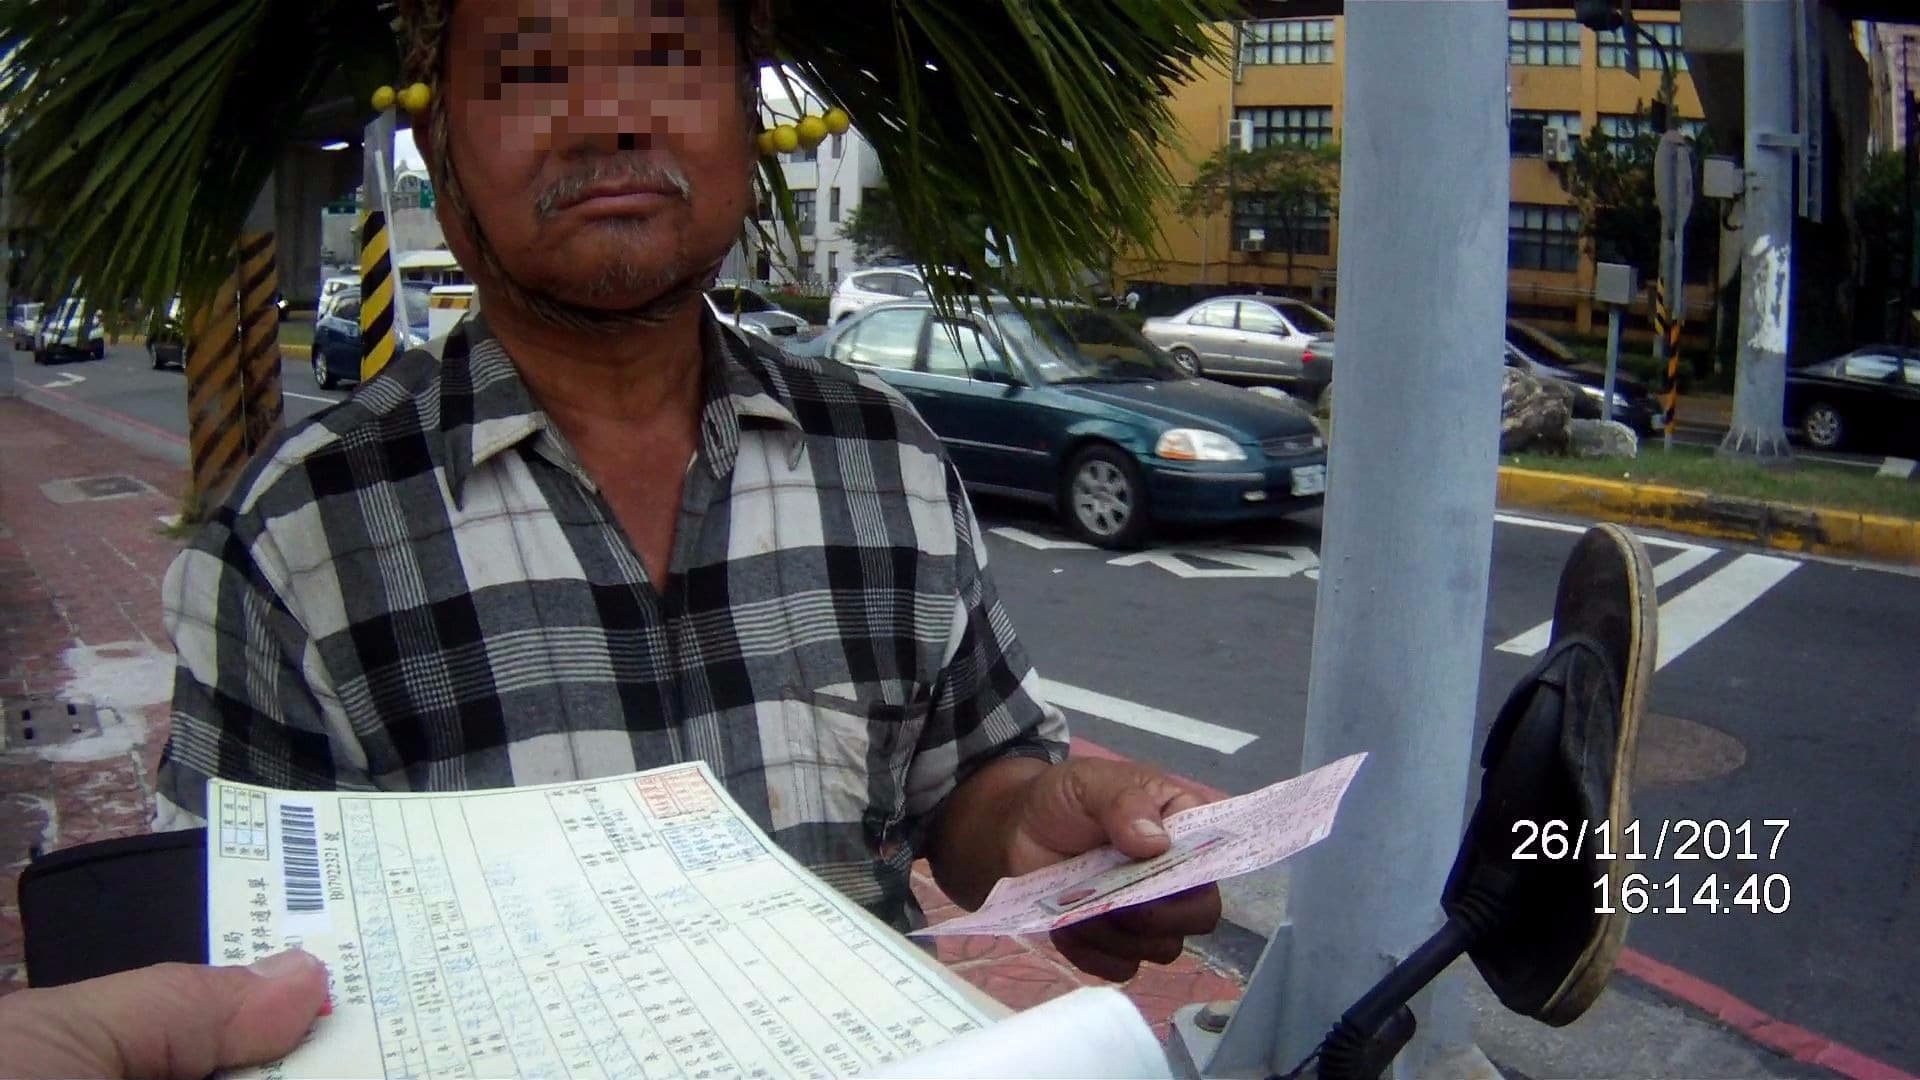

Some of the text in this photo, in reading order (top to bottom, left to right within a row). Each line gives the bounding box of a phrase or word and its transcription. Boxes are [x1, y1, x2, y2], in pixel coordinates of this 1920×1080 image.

[248, 877, 274, 960] 事件通知單
